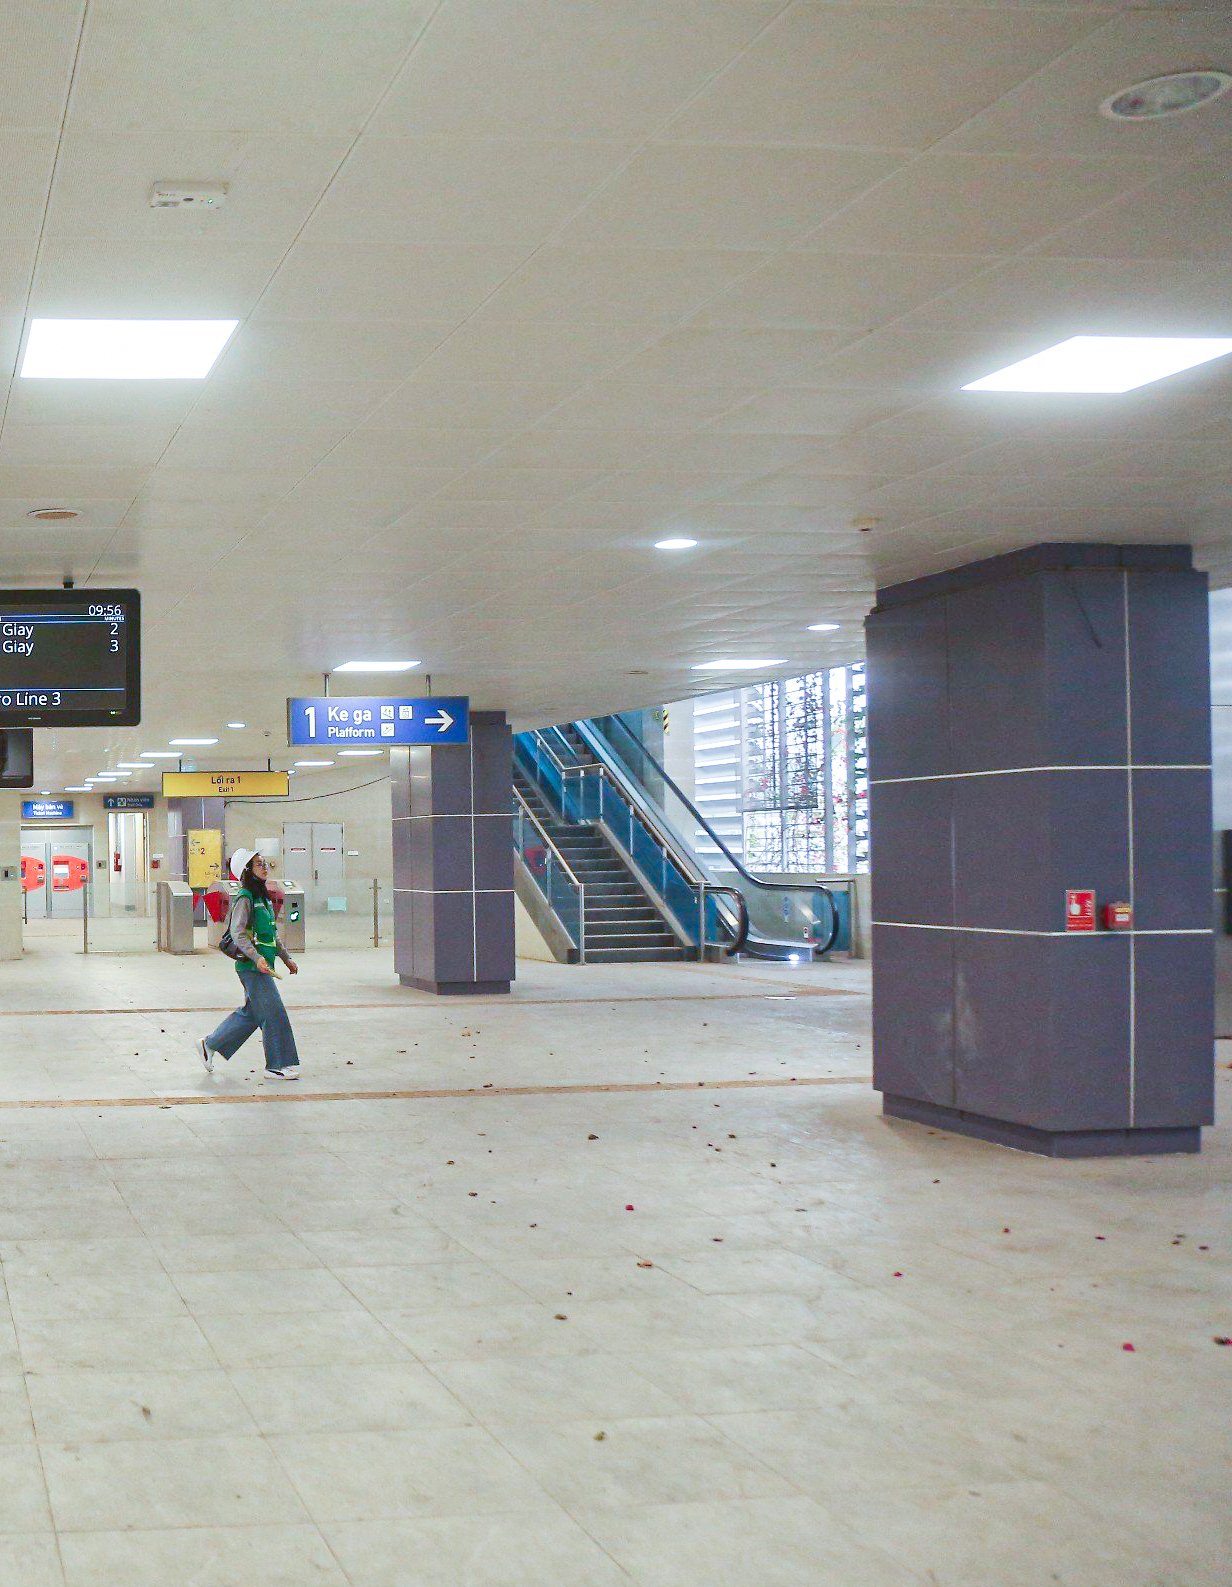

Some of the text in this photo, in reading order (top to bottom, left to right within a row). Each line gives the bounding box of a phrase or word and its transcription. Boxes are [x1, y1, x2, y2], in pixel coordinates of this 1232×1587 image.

[88, 605, 122, 616] 09:56
[2, 623, 34, 640] Giay
[110, 622, 119, 635] 2
[2, 640, 34, 657] Giay
[110, 639, 119, 652] 3
[16, 692, 48, 706] Line
[51, 692, 61, 706] 3
[304, 706, 316, 738] 1
[327, 706, 372, 725] Ke ga
[327, 726, 375, 738] Platform
[200, 847, 206, 855] 2
